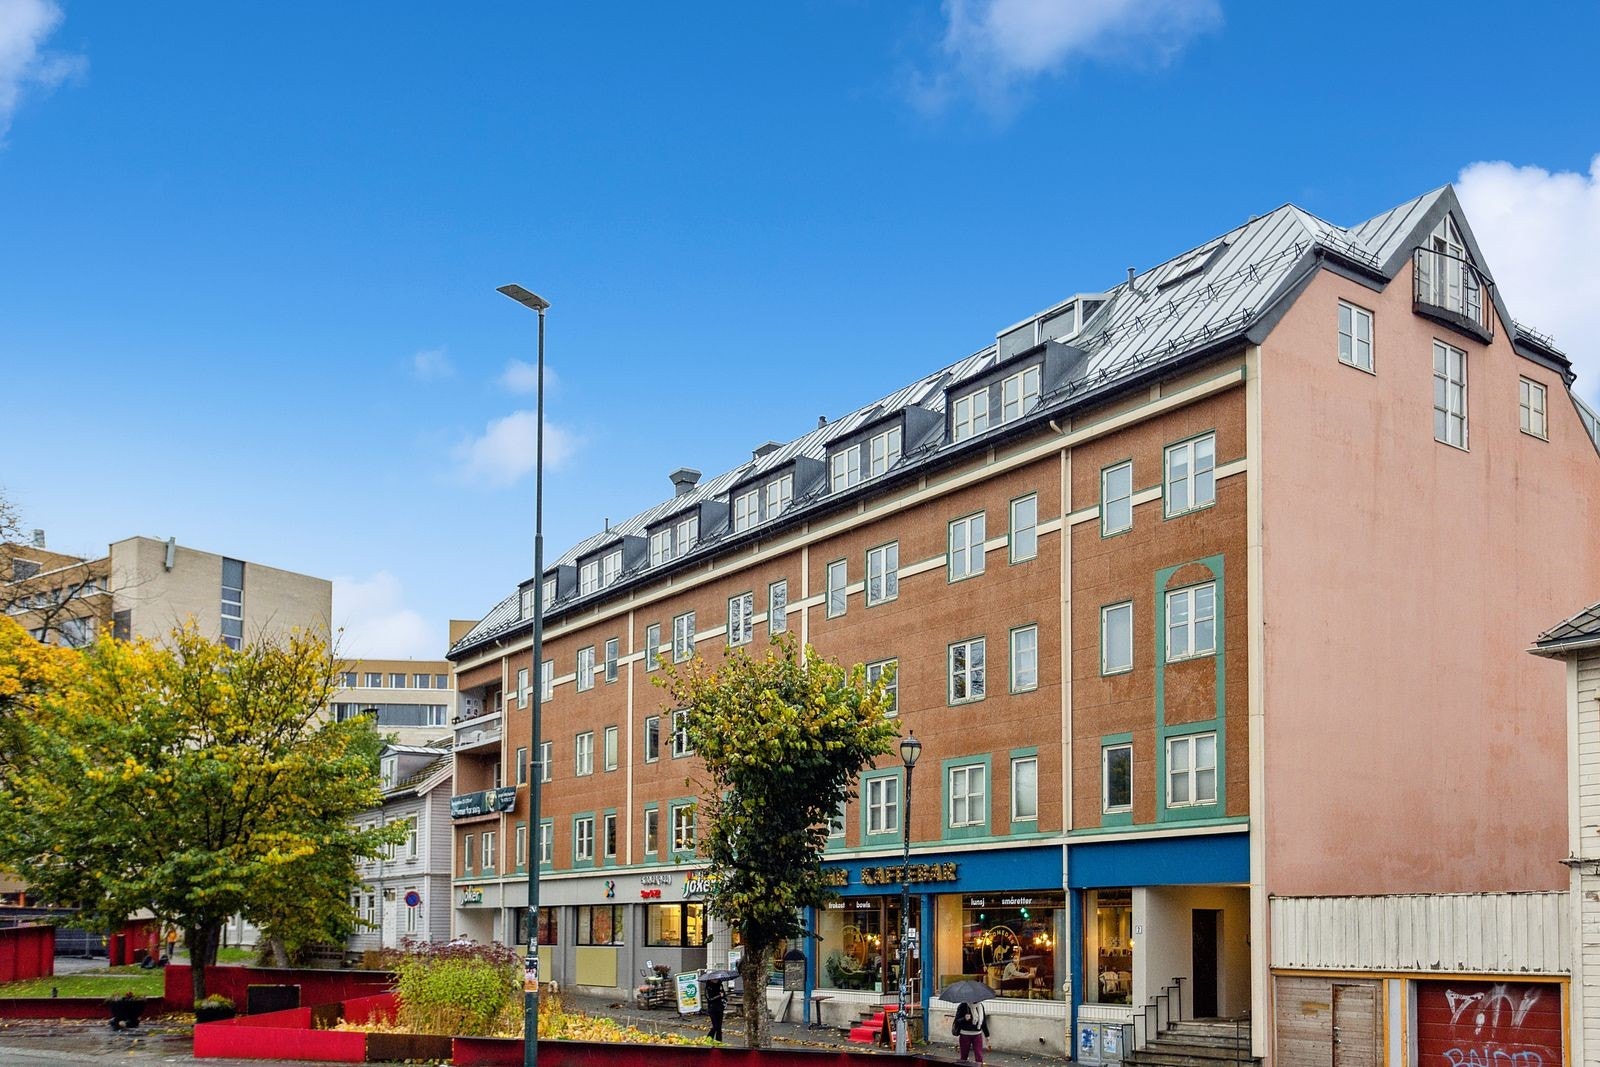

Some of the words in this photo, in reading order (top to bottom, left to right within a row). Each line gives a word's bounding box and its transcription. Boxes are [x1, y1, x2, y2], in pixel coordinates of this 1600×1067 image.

[861, 862, 957, 885] KAFFEBAR
[856, 901, 871, 909] bowls
[970, 897, 985, 907] lunsj
[1001, 896, 1032, 905] småretter
